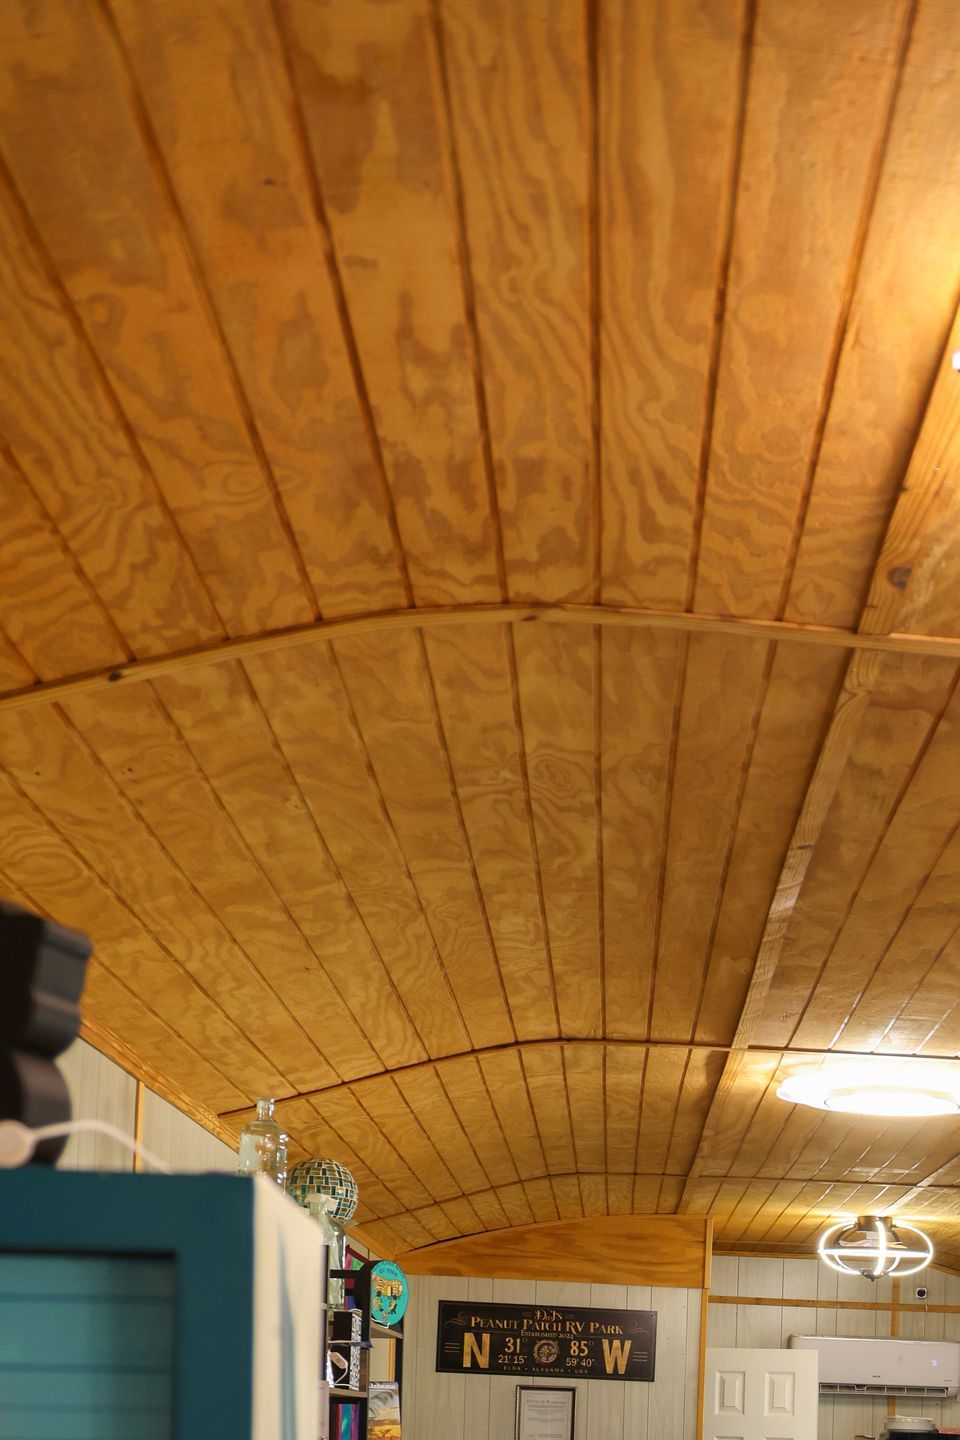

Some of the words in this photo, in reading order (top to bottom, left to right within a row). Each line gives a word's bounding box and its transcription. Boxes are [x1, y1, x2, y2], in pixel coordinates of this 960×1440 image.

[470, 1316, 518, 1329] PEANUT
[523, 1319, 562, 1331] PATCH
[566, 1321, 585, 1335] RV
[590, 1322, 623, 1335] PARK
[463, 1332, 490, 1368] N
[601, 1338, 632, 1375] W
